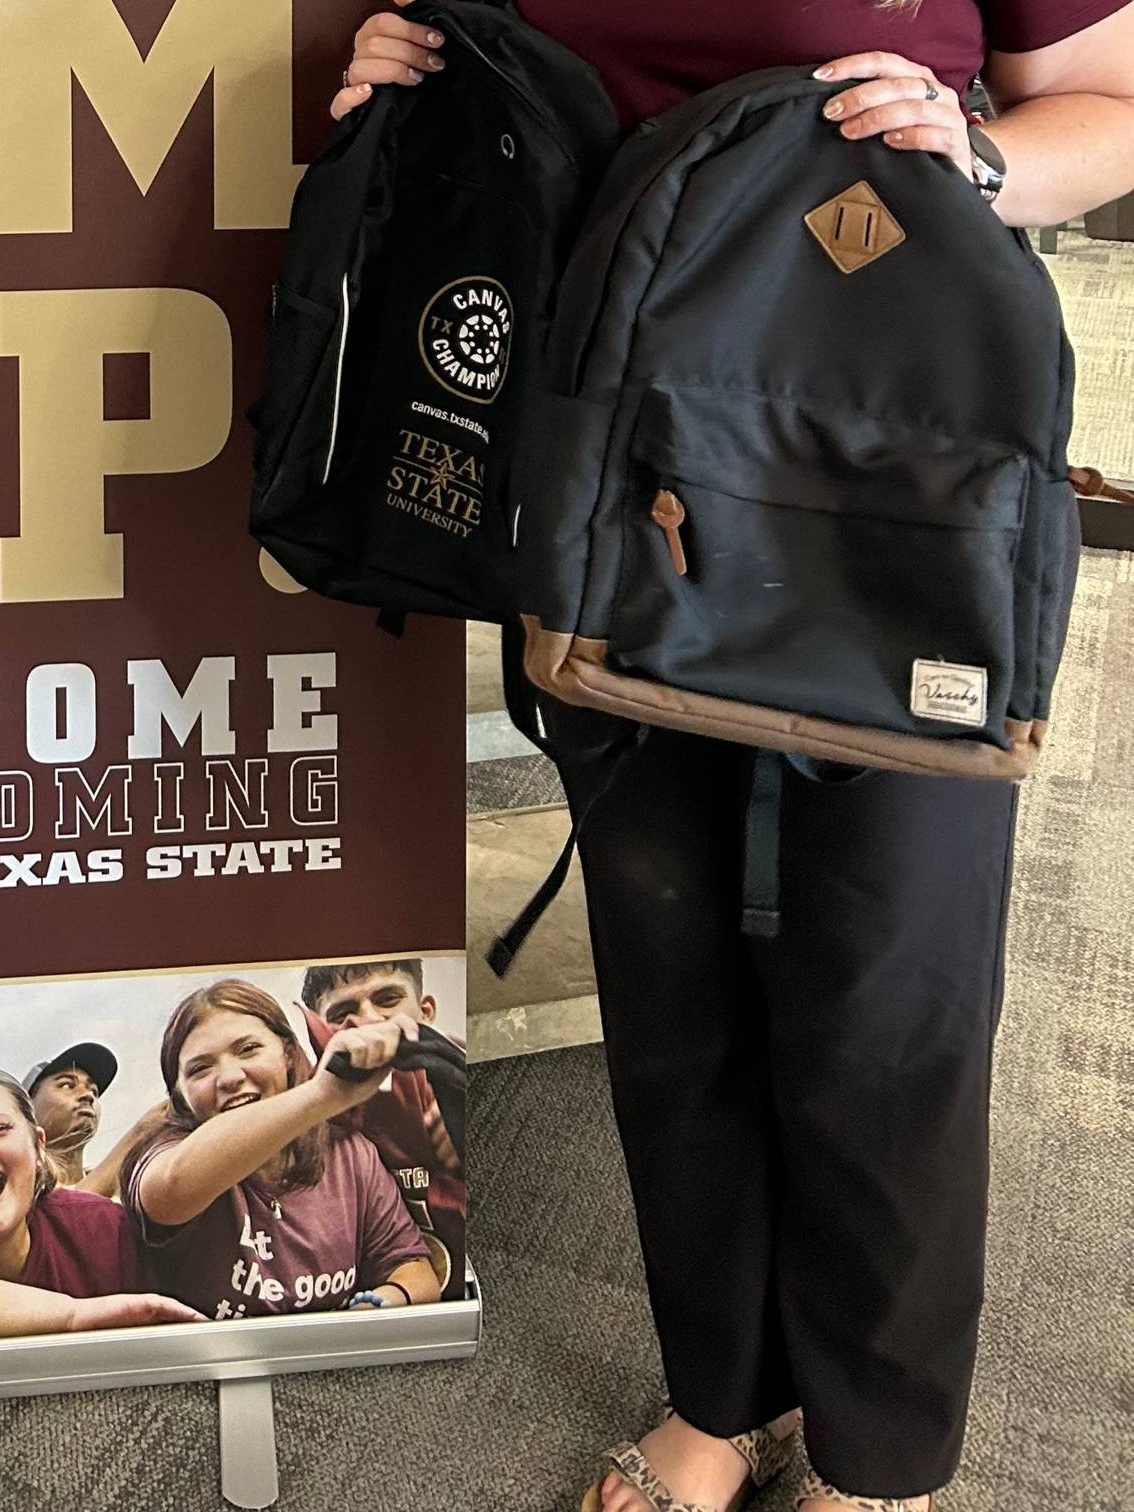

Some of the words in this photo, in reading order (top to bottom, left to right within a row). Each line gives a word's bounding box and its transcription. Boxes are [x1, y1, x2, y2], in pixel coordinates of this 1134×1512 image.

[430, 315, 454, 335] TX
[452, 288, 511, 335] CANVAS
[432, 338, 501, 390] CHAMPION
[411, 400, 489, 445] canvas.txstate
[398, 429, 485, 487] TEXA
[386, 492, 472, 538] UNIVERSITY
[387, 466, 482, 524] STATE
[146, 836, 343, 880] STATE
[395, 1167, 430, 1189] TA
[231, 1258, 285, 1302] the
[294, 1264, 356, 1308] good
